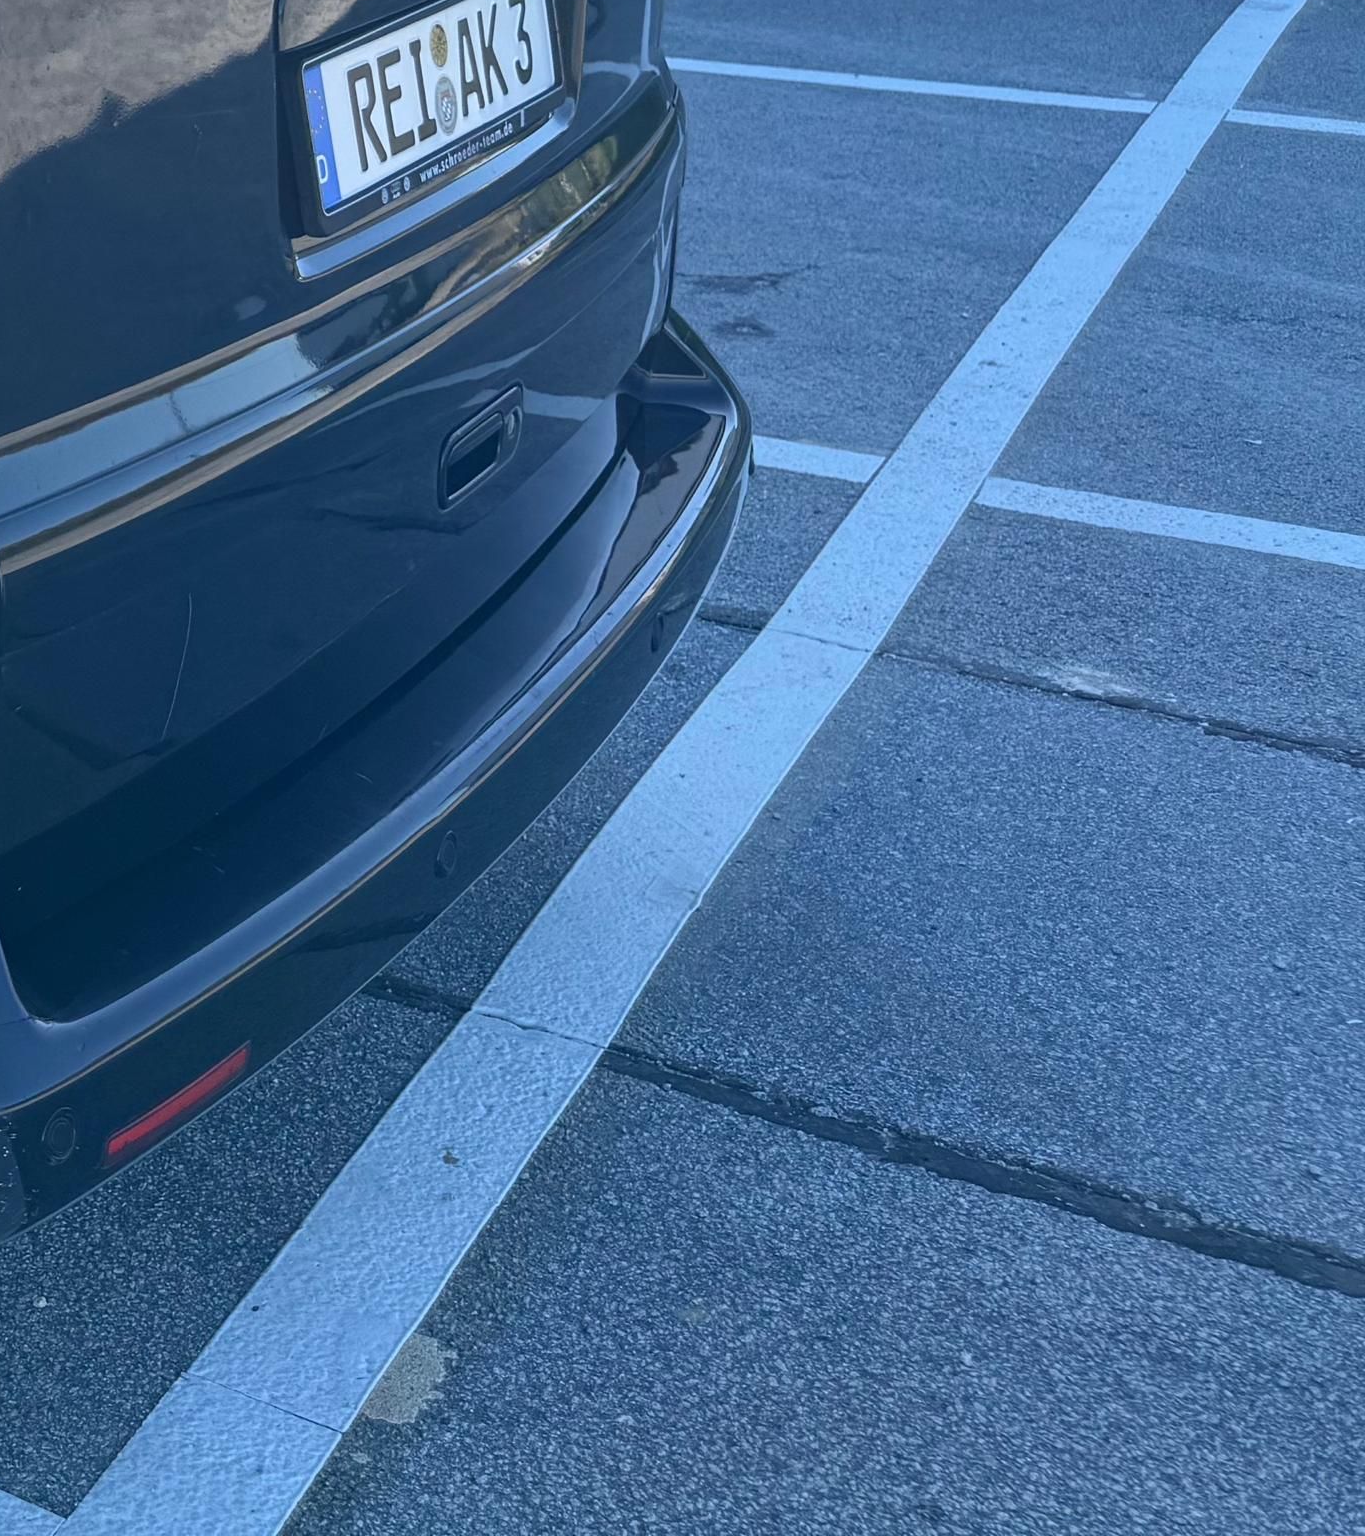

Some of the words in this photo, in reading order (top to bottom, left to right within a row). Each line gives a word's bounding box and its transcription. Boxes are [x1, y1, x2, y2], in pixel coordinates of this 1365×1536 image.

[347, 39, 437, 172] REI
[457, 3, 508, 117] AK
[316, 154, 329, 184] D
[419, 121, 513, 182] www.schroeder-team.de
